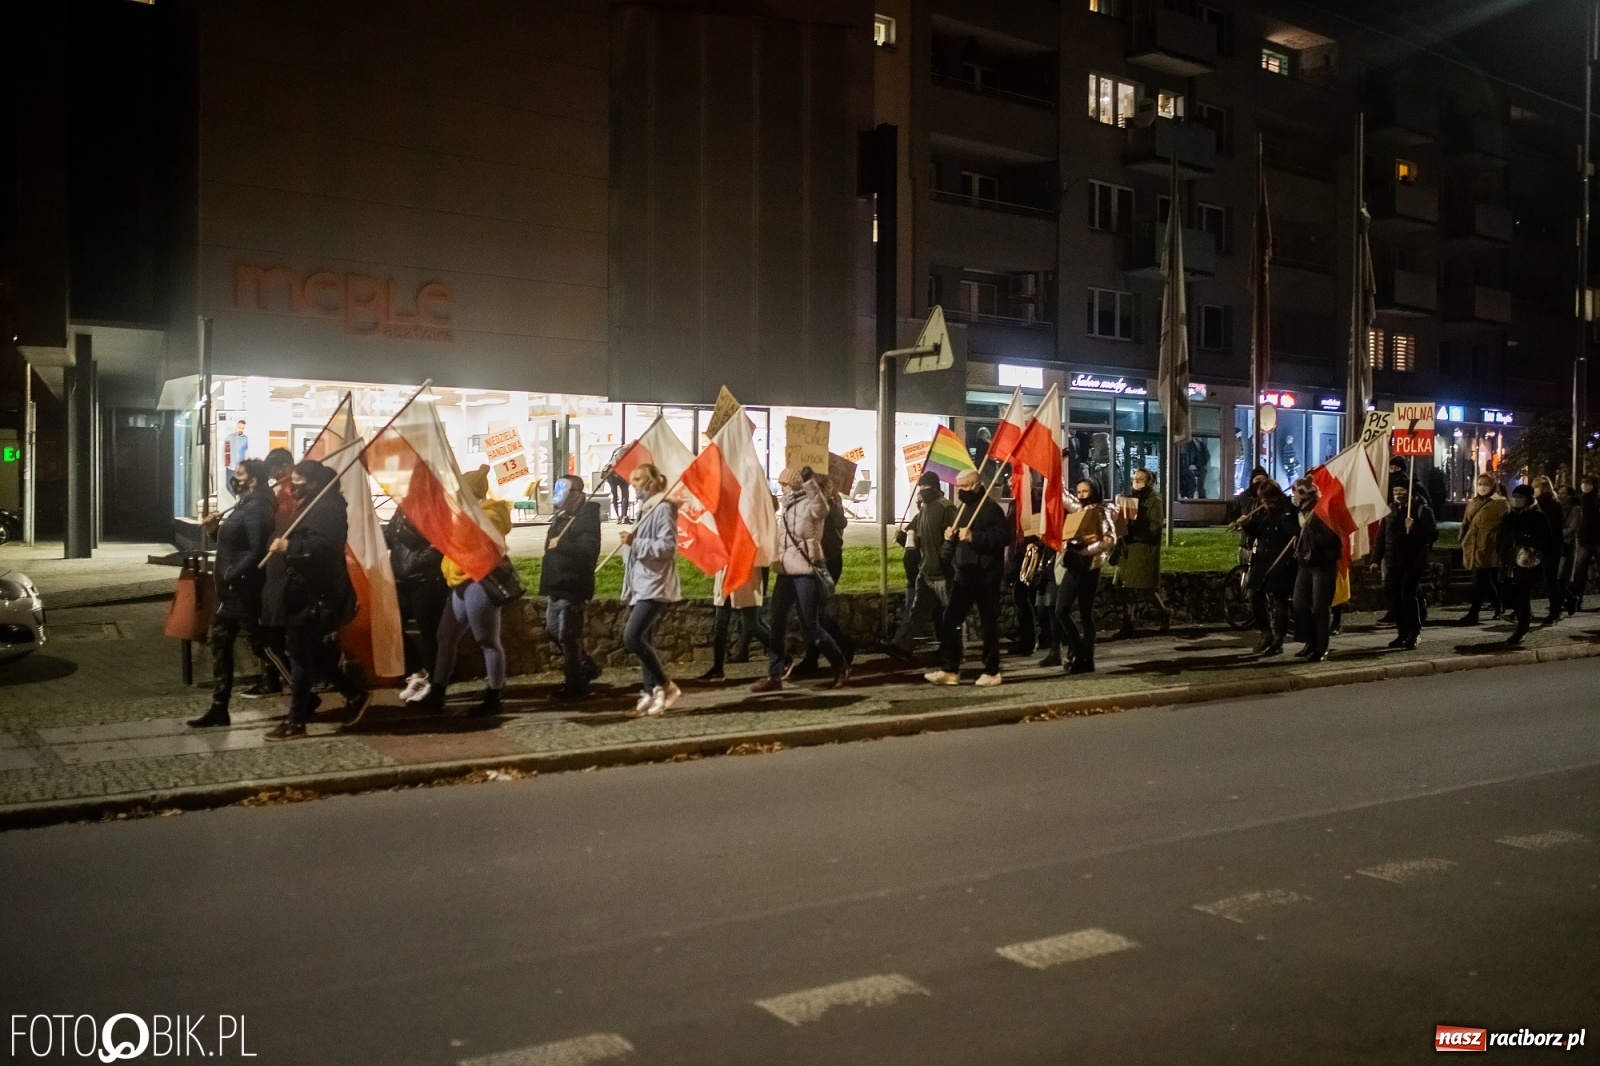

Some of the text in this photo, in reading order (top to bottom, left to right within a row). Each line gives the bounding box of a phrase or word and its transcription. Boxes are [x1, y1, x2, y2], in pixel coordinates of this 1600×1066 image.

[1072, 374, 1100, 388] Salon
[1100, 378, 1127, 393] mody
[1369, 413, 1391, 429] PIS
[1397, 406, 1434, 421] WOLNA
[1396, 437, 1433, 453] POLKA
[503, 459, 517, 472] 13
